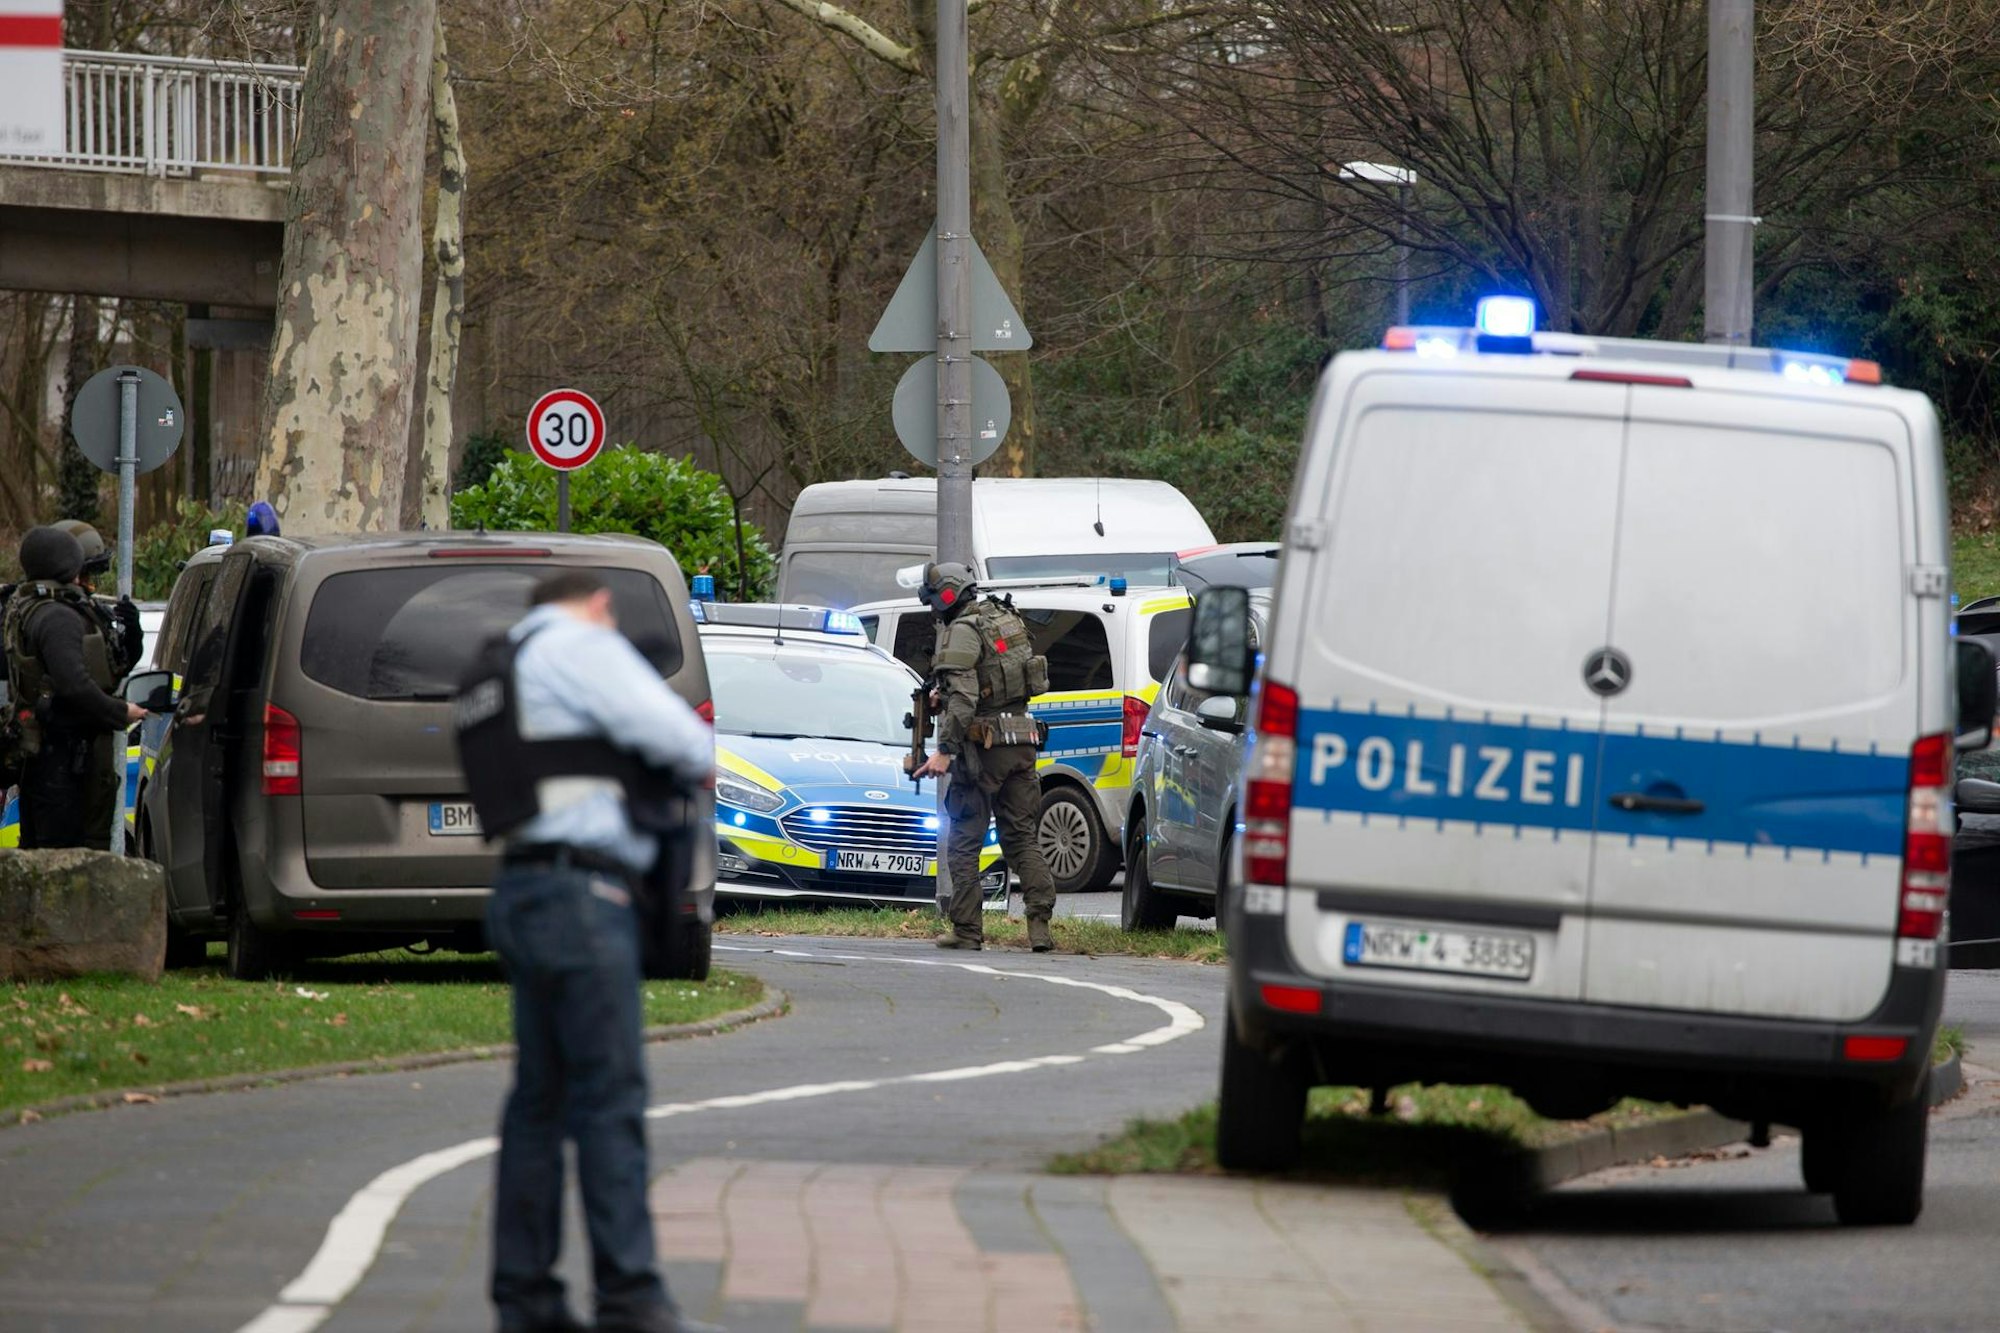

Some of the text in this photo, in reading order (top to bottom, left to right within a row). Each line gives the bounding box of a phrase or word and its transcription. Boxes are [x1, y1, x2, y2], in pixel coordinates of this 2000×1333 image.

[545, 412, 587, 447] 30
[788, 752, 903, 767] POLIZ
[1310, 732, 1584, 807] POLIZEI
[443, 806, 473, 828] BM
[837, 852, 864, 868] NRW
[1363, 930, 1413, 957] NRW
